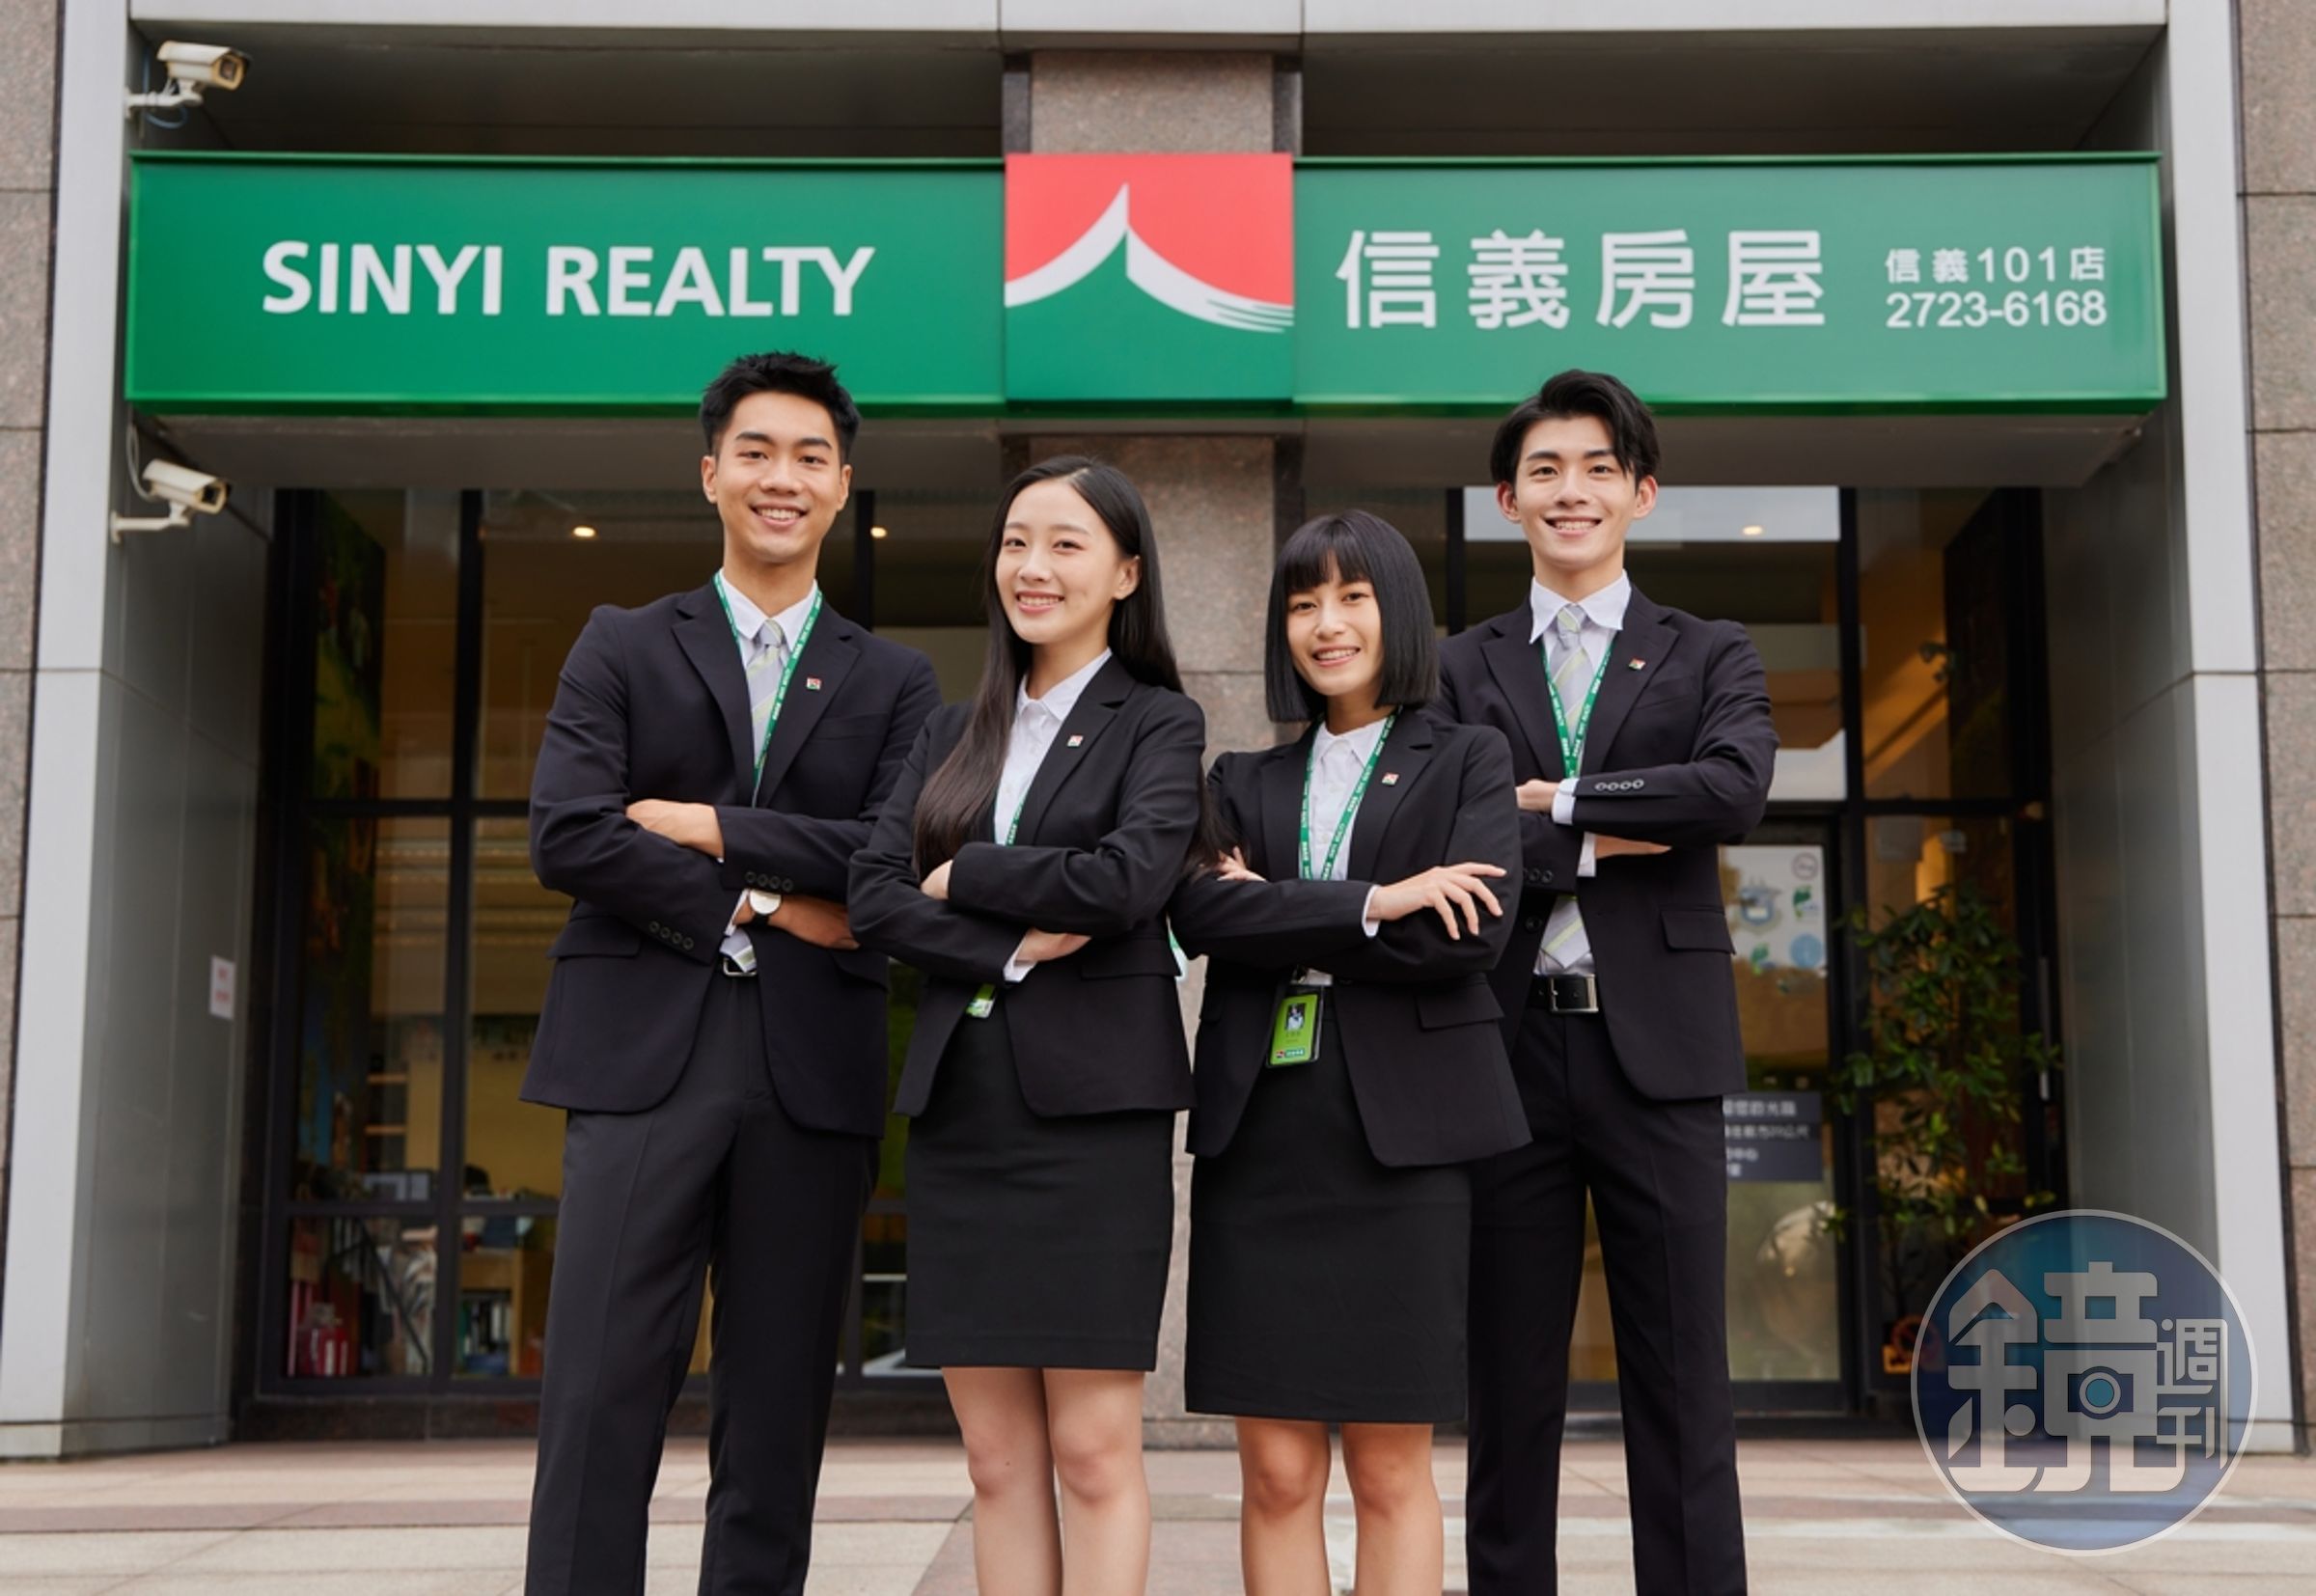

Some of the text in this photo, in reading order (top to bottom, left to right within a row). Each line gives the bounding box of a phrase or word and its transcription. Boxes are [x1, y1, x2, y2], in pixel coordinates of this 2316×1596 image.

[262, 240, 875, 317] SINYI REALTY
[1336, 229, 1826, 330] 信義房屋
[1885, 246, 2106, 284] 信義101店
[1886, 289, 2108, 328] 2723-6168
